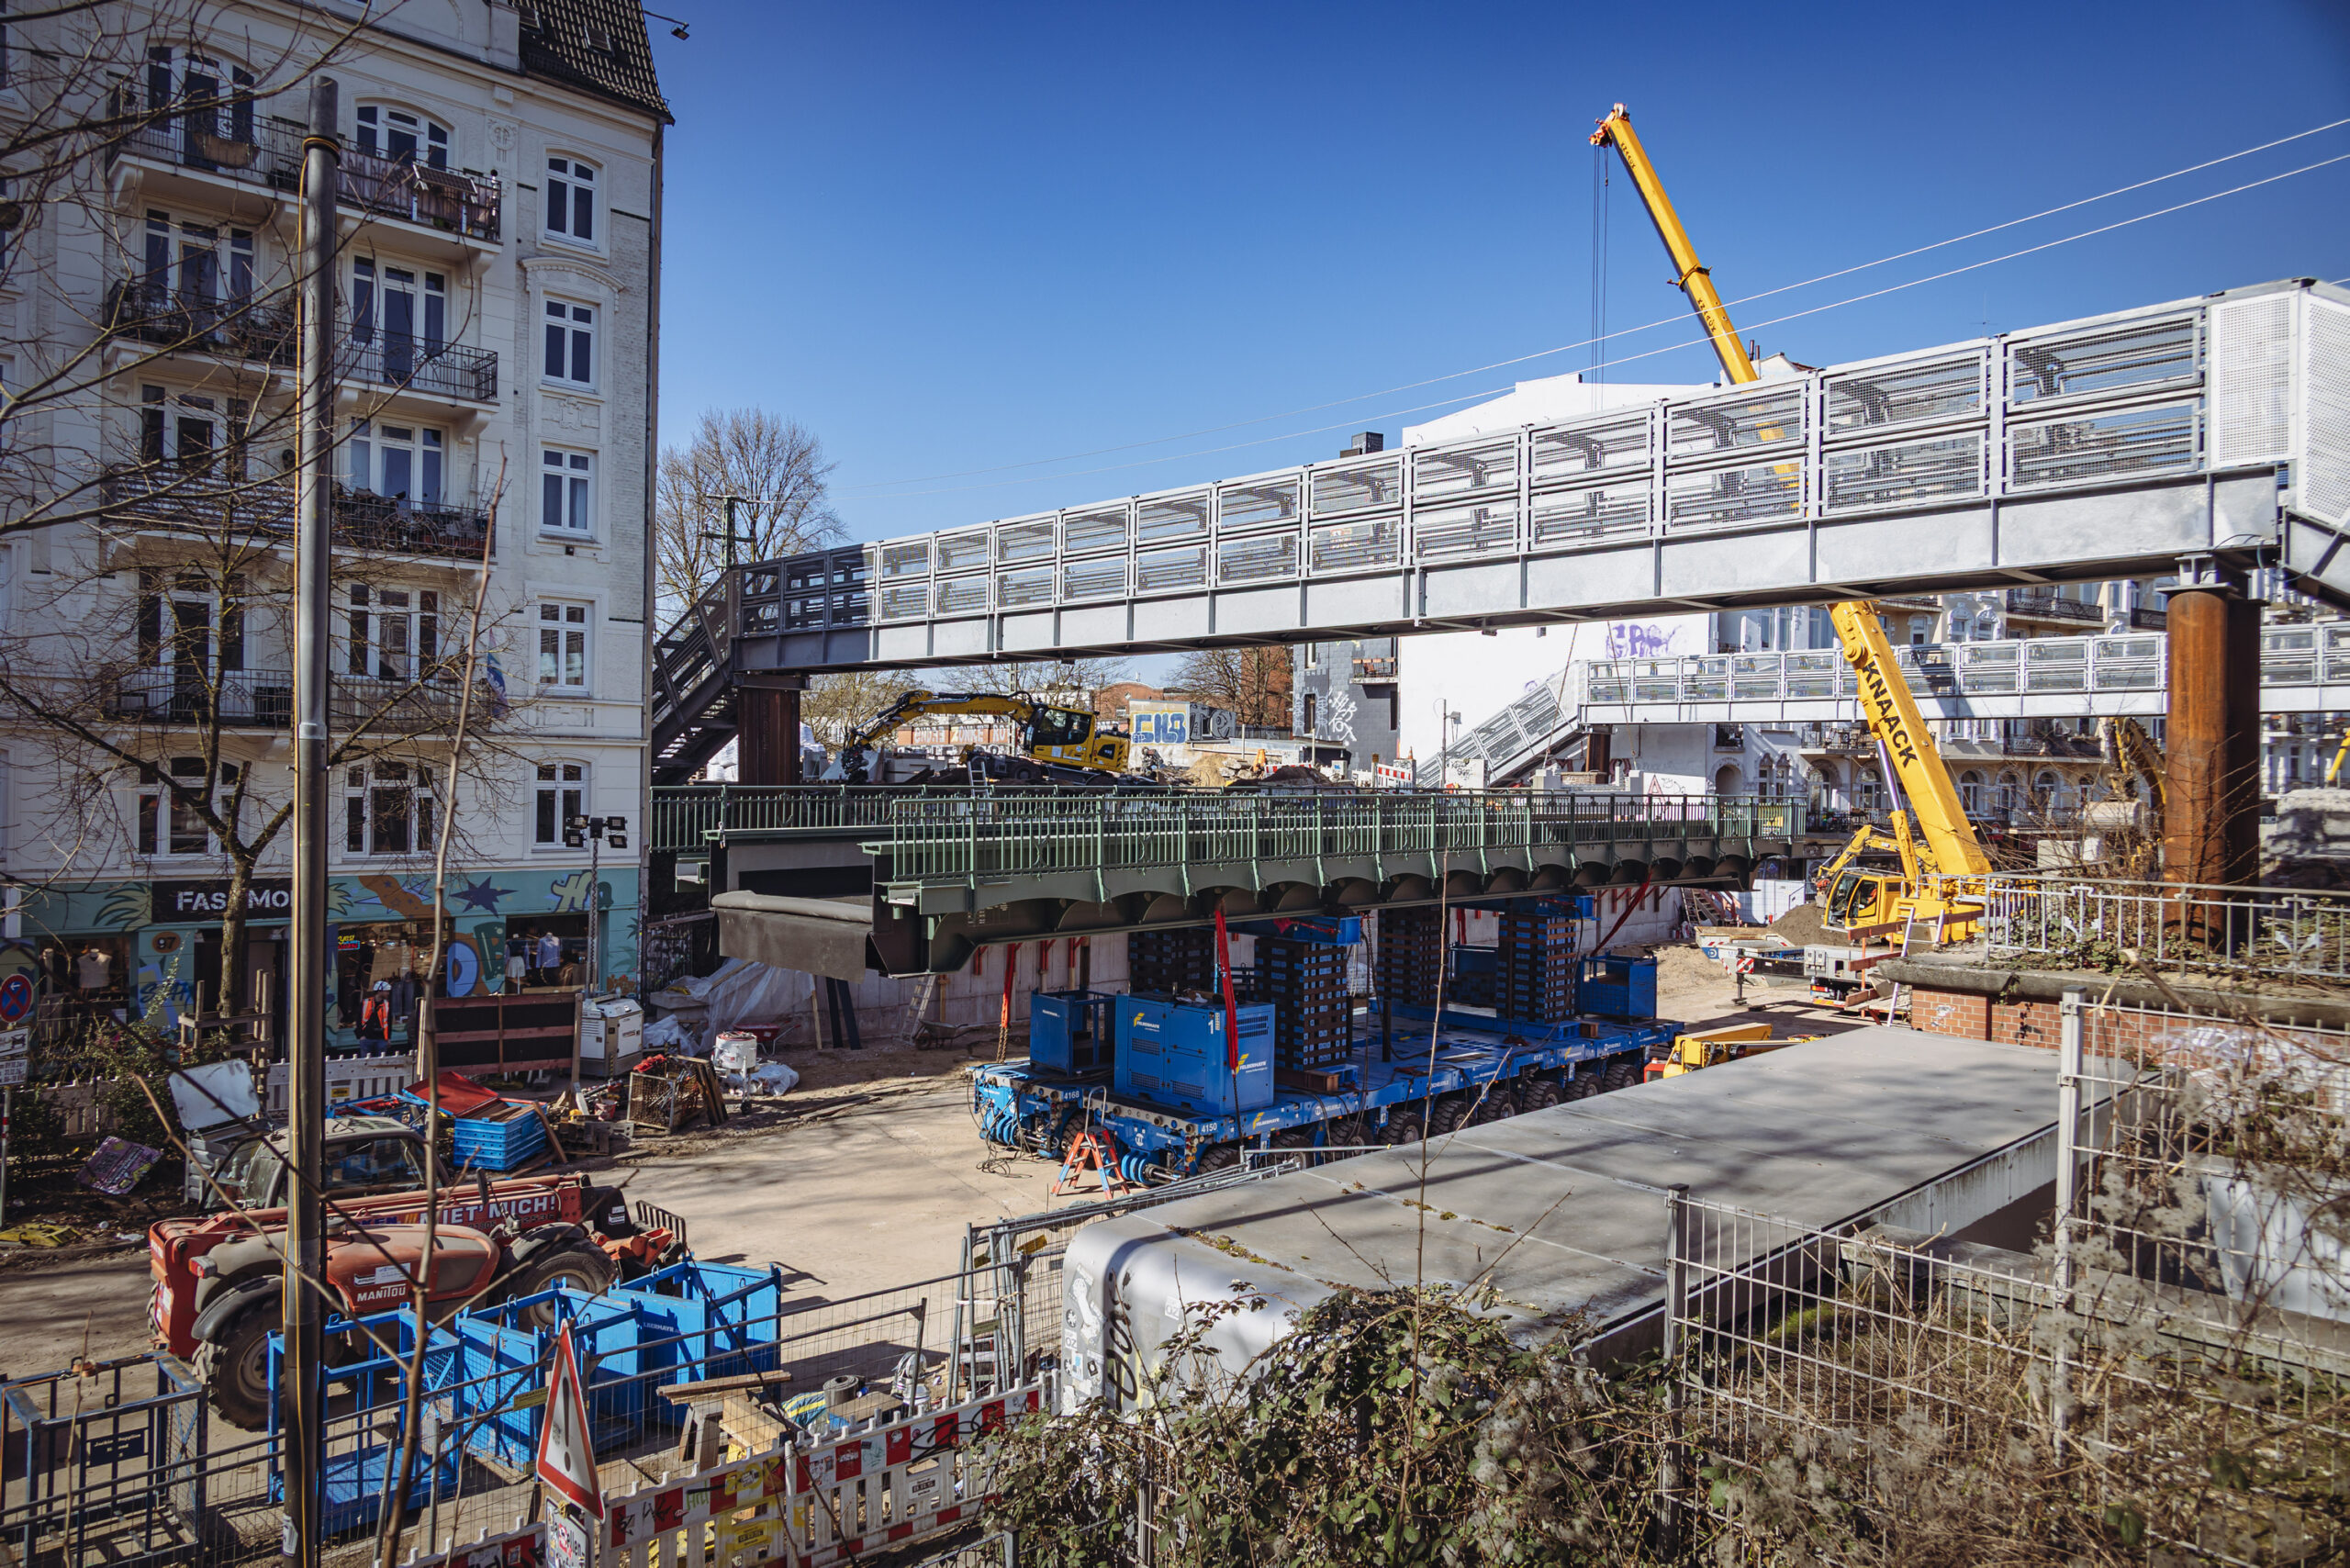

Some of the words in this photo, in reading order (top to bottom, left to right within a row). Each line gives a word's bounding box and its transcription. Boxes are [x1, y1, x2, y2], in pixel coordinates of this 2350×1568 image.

[1862, 661, 1919, 768] KNAACK
[177, 889, 294, 912] FASMO
[156, 936, 175, 950] 97
[1208, 1019, 1214, 1035] 1
[1063, 1091, 1080, 1101] 4168
[1201, 1123, 1217, 1133] 4150
[488, 1195, 556, 1219] MICH!
[356, 1283, 407, 1303] MANITOU
